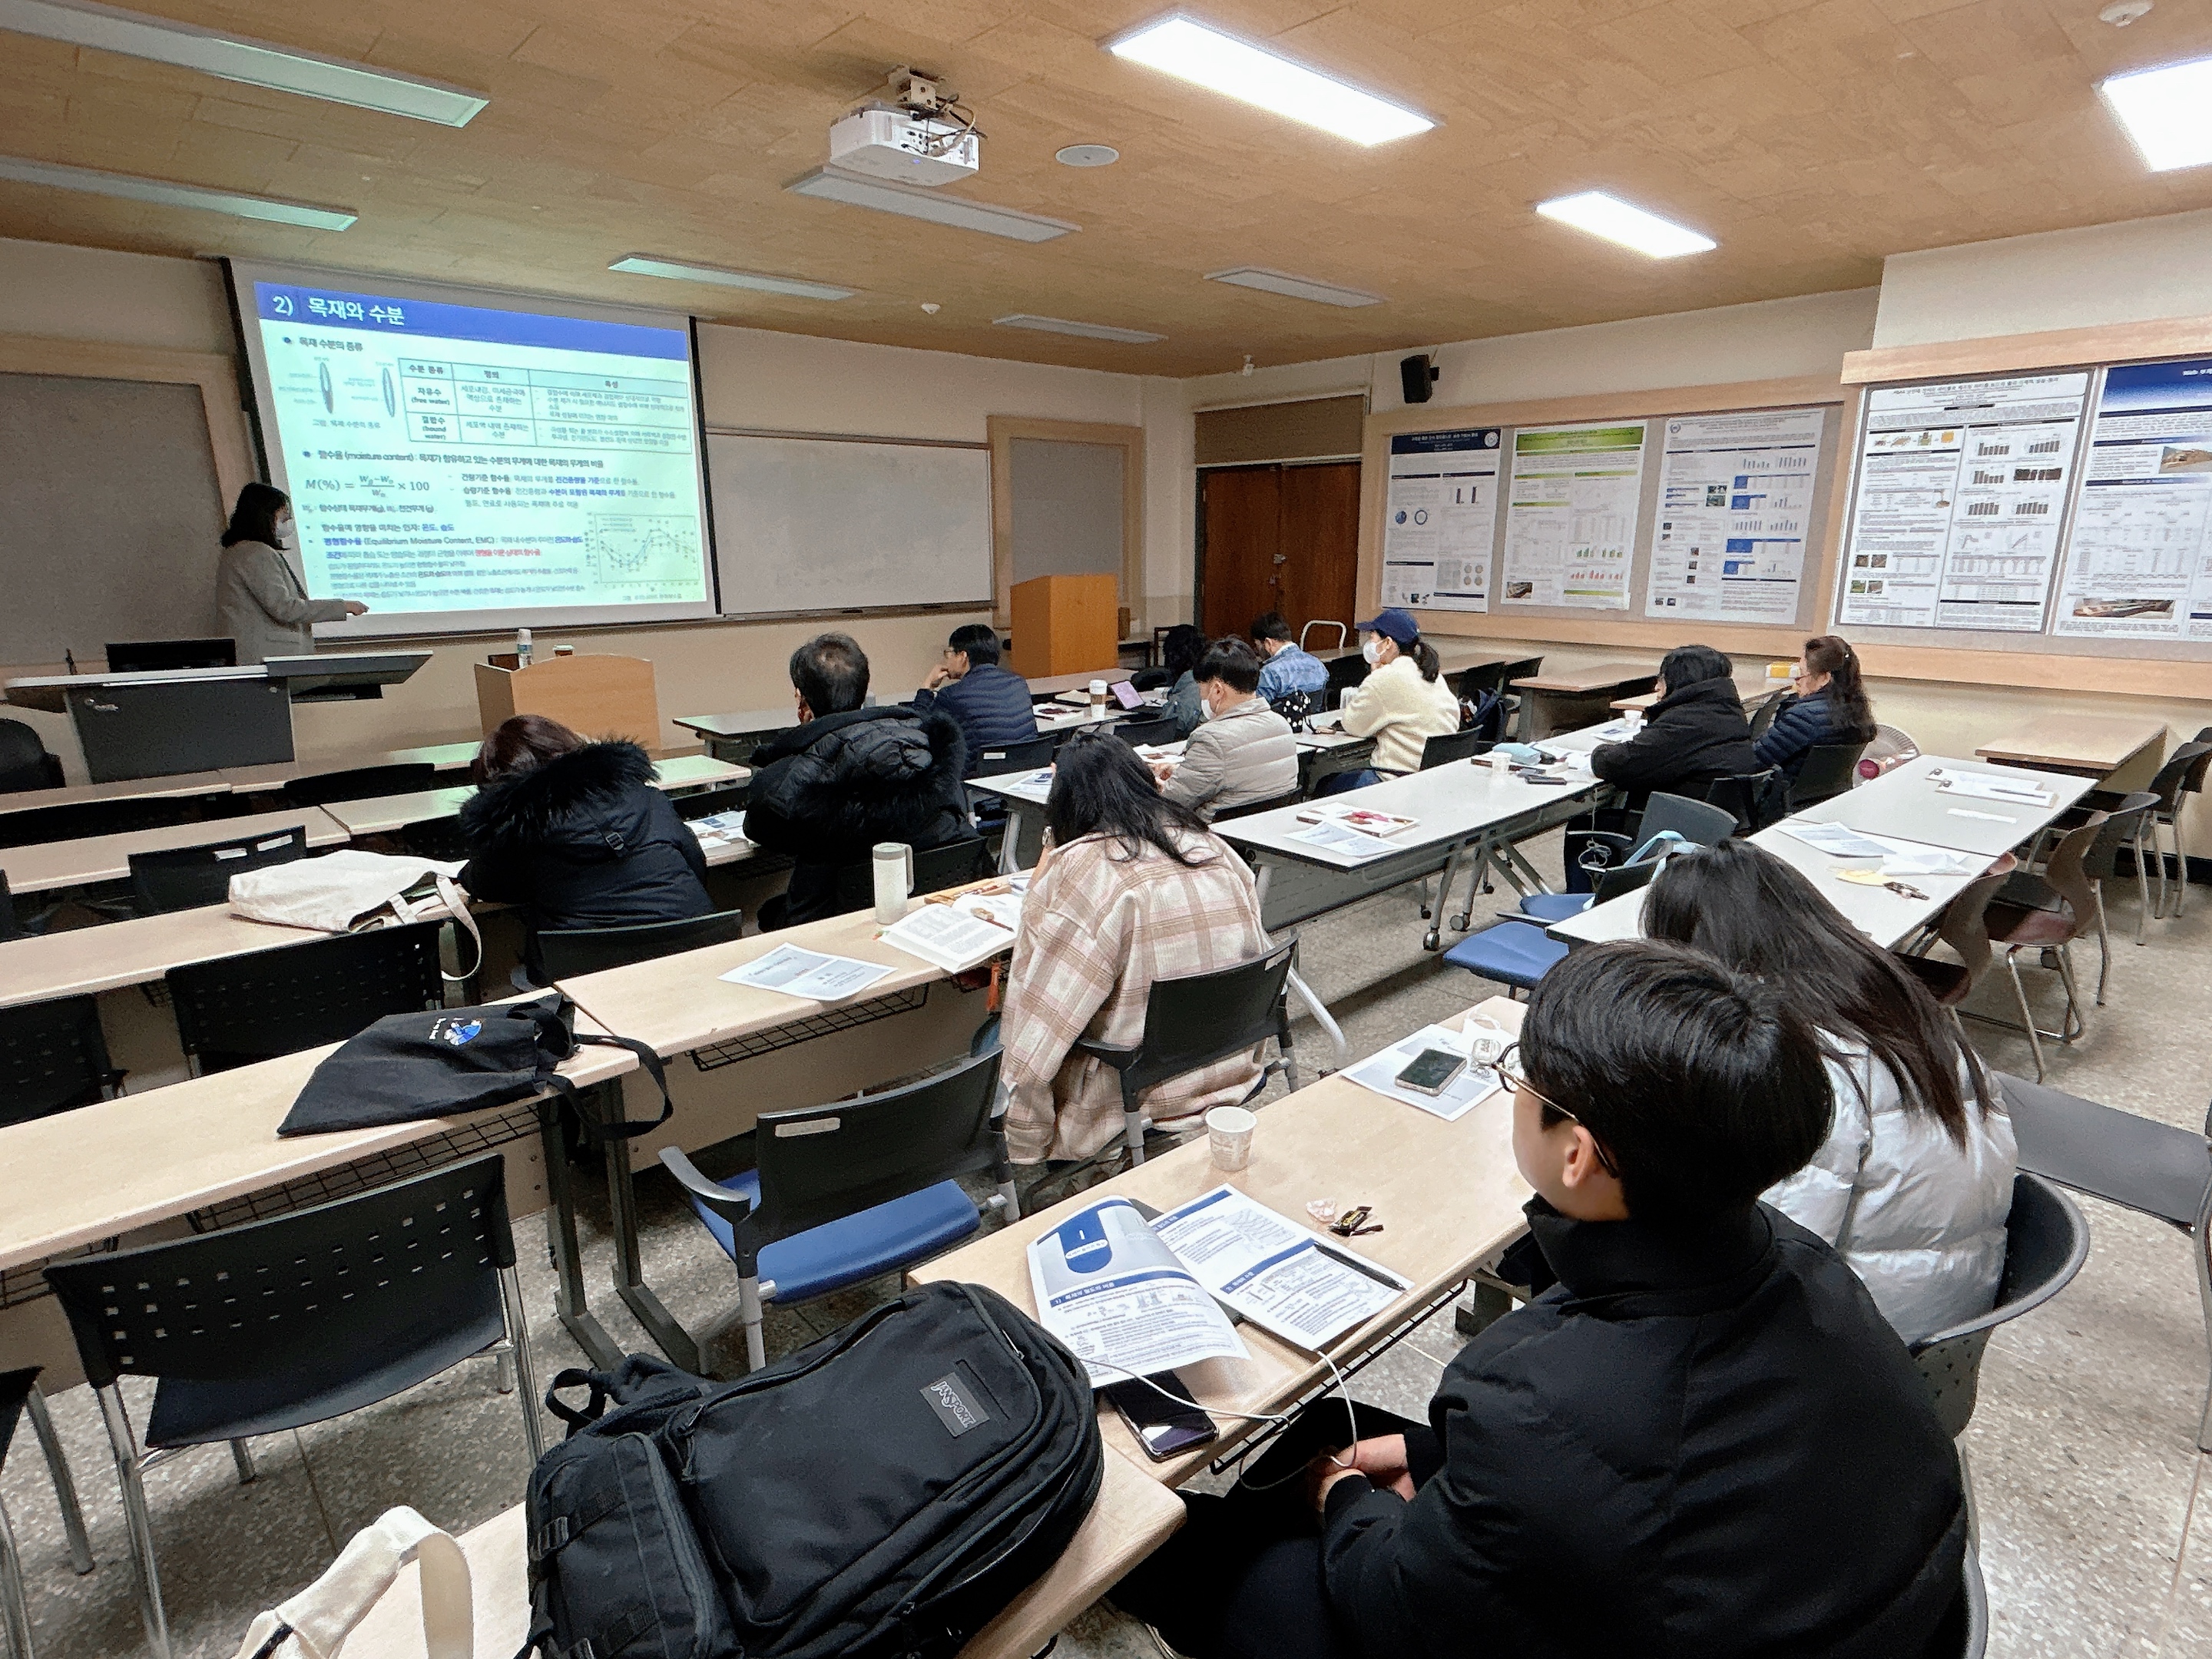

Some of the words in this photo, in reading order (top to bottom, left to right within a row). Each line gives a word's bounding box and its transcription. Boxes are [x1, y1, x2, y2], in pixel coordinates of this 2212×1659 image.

[273, 296, 294, 316] 2)
[308, 296, 365, 321] 목재와
[369, 306, 405, 326] 수분
[409, 364, 424, 373] 수분
[410, 482, 429, 491] 100
[364, 538, 409, 546] (Equilibrium
[930, 1380, 976, 1429] JANSPORT
